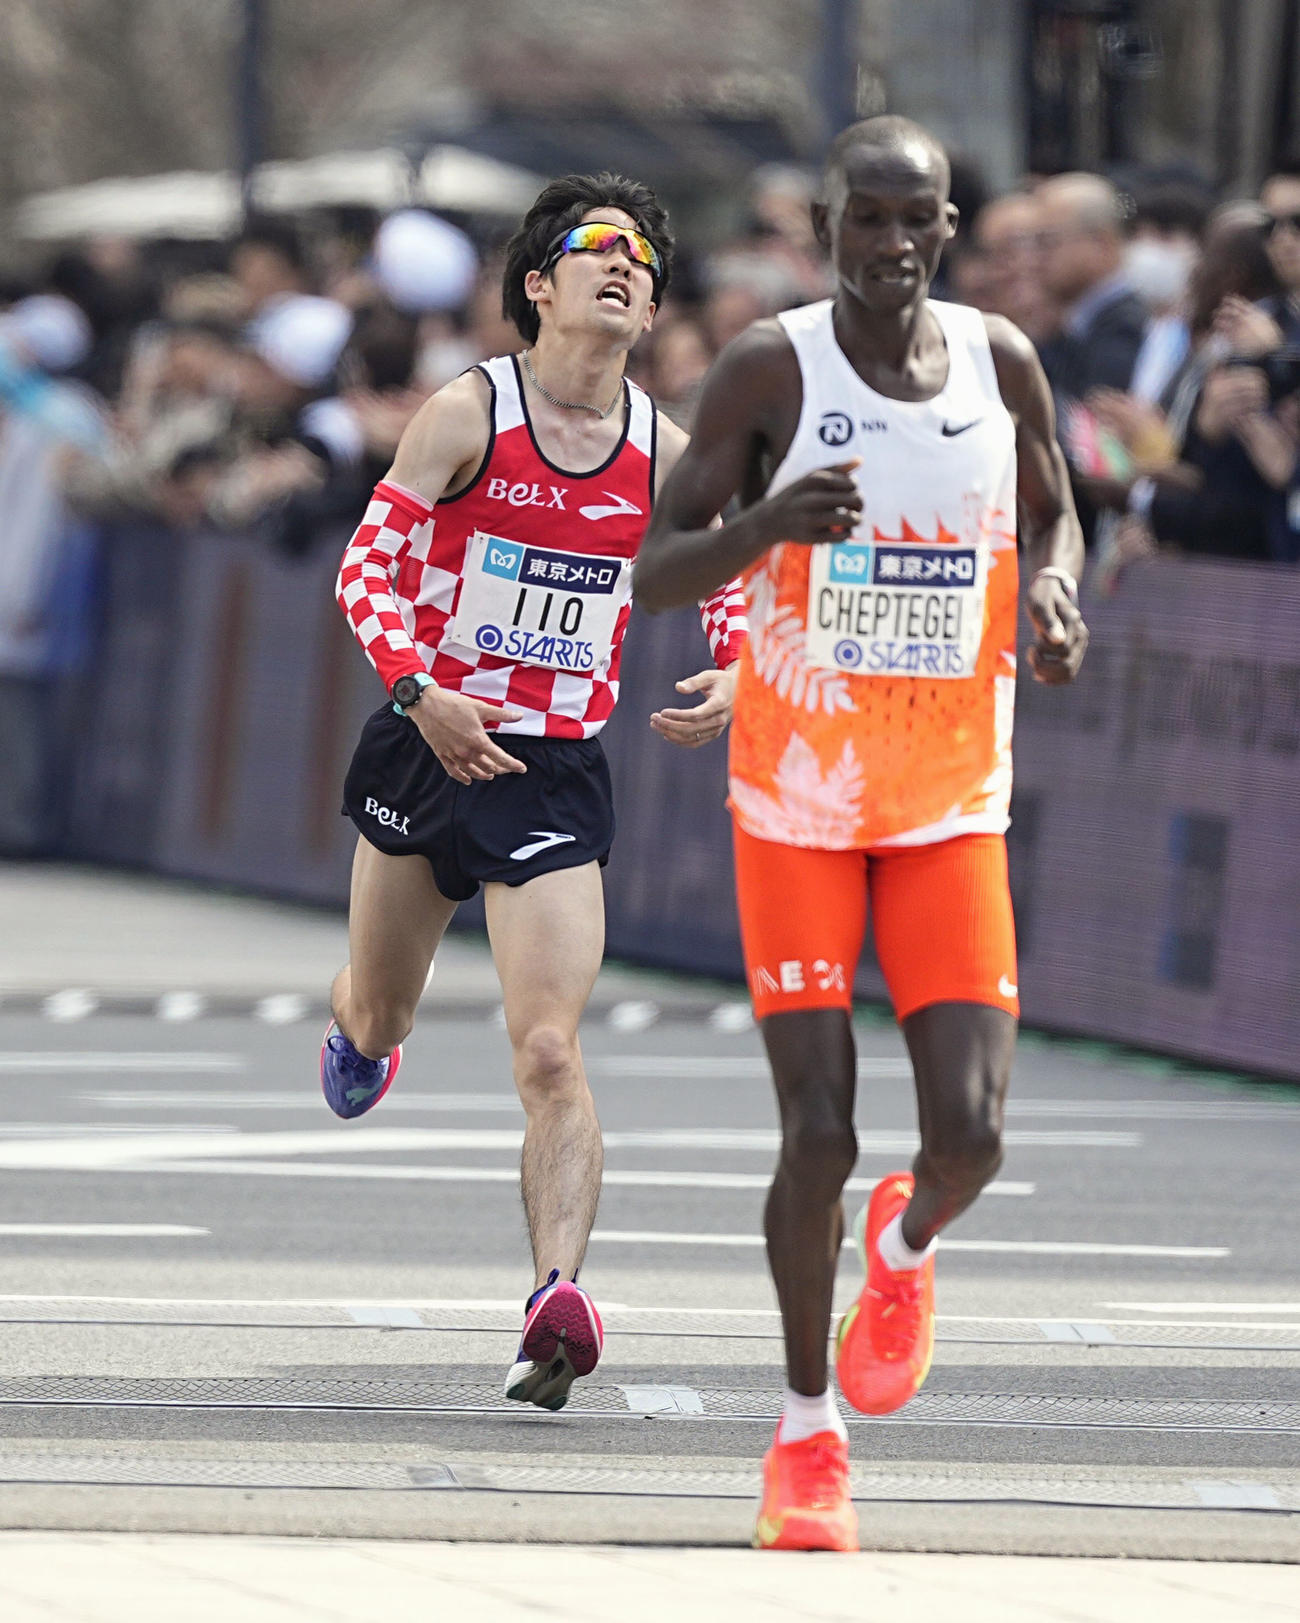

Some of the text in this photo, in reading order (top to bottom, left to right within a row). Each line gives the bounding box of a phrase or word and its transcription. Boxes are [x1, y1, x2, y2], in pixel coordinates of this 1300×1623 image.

[527, 558, 613, 585] 東京メトロ
[878, 554, 973, 581] 東京メトロ
[512, 588, 584, 636] 110
[818, 587, 963, 639] CHEPTEGEI
